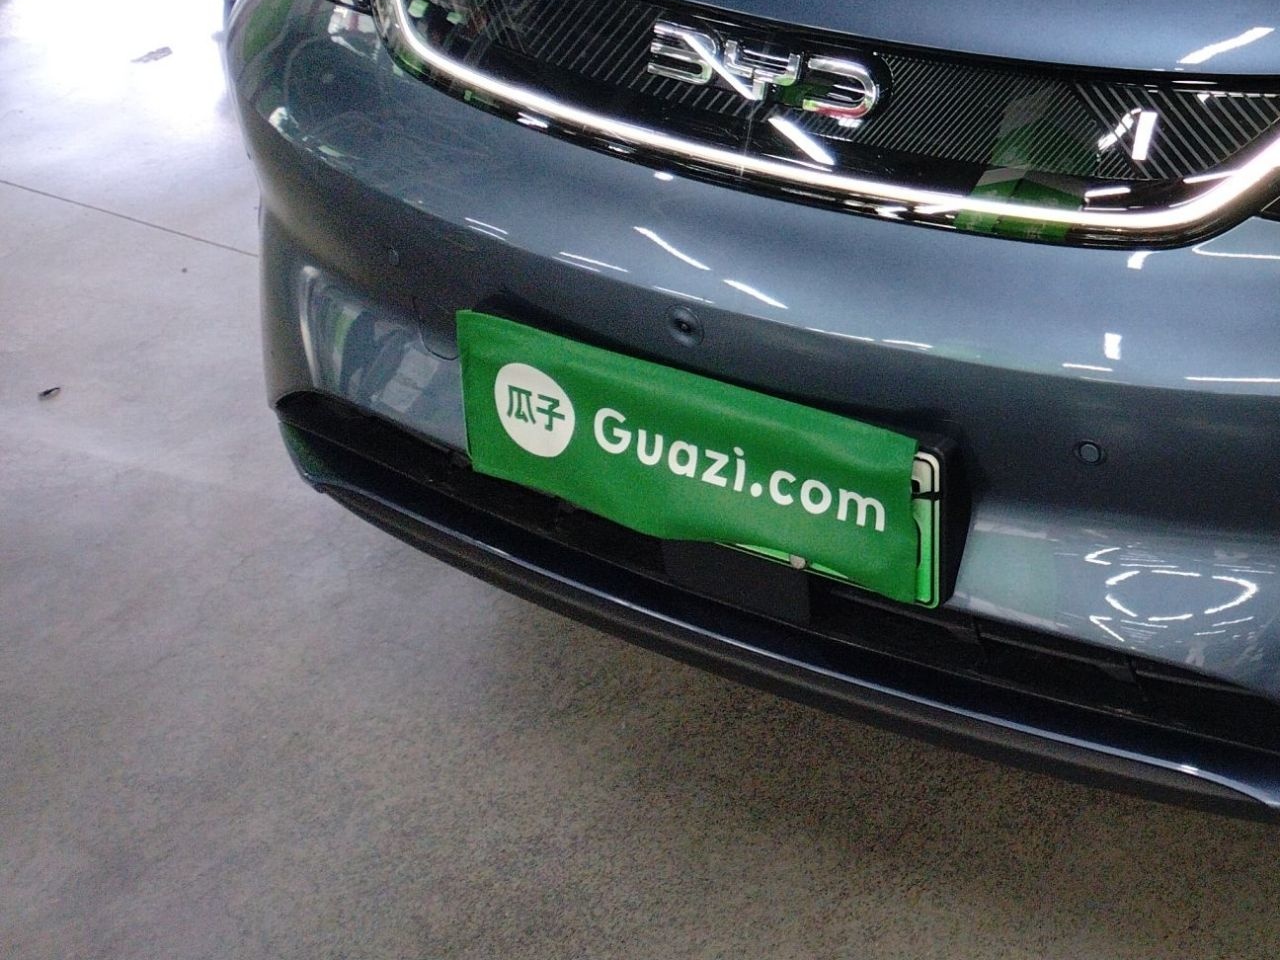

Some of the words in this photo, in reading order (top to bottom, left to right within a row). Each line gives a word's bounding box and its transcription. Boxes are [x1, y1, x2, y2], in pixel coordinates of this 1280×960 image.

[648, 19, 878, 119] BYD
[507, 385, 566, 432] 瓜子
[593, 407, 886, 532] Guazi.com
